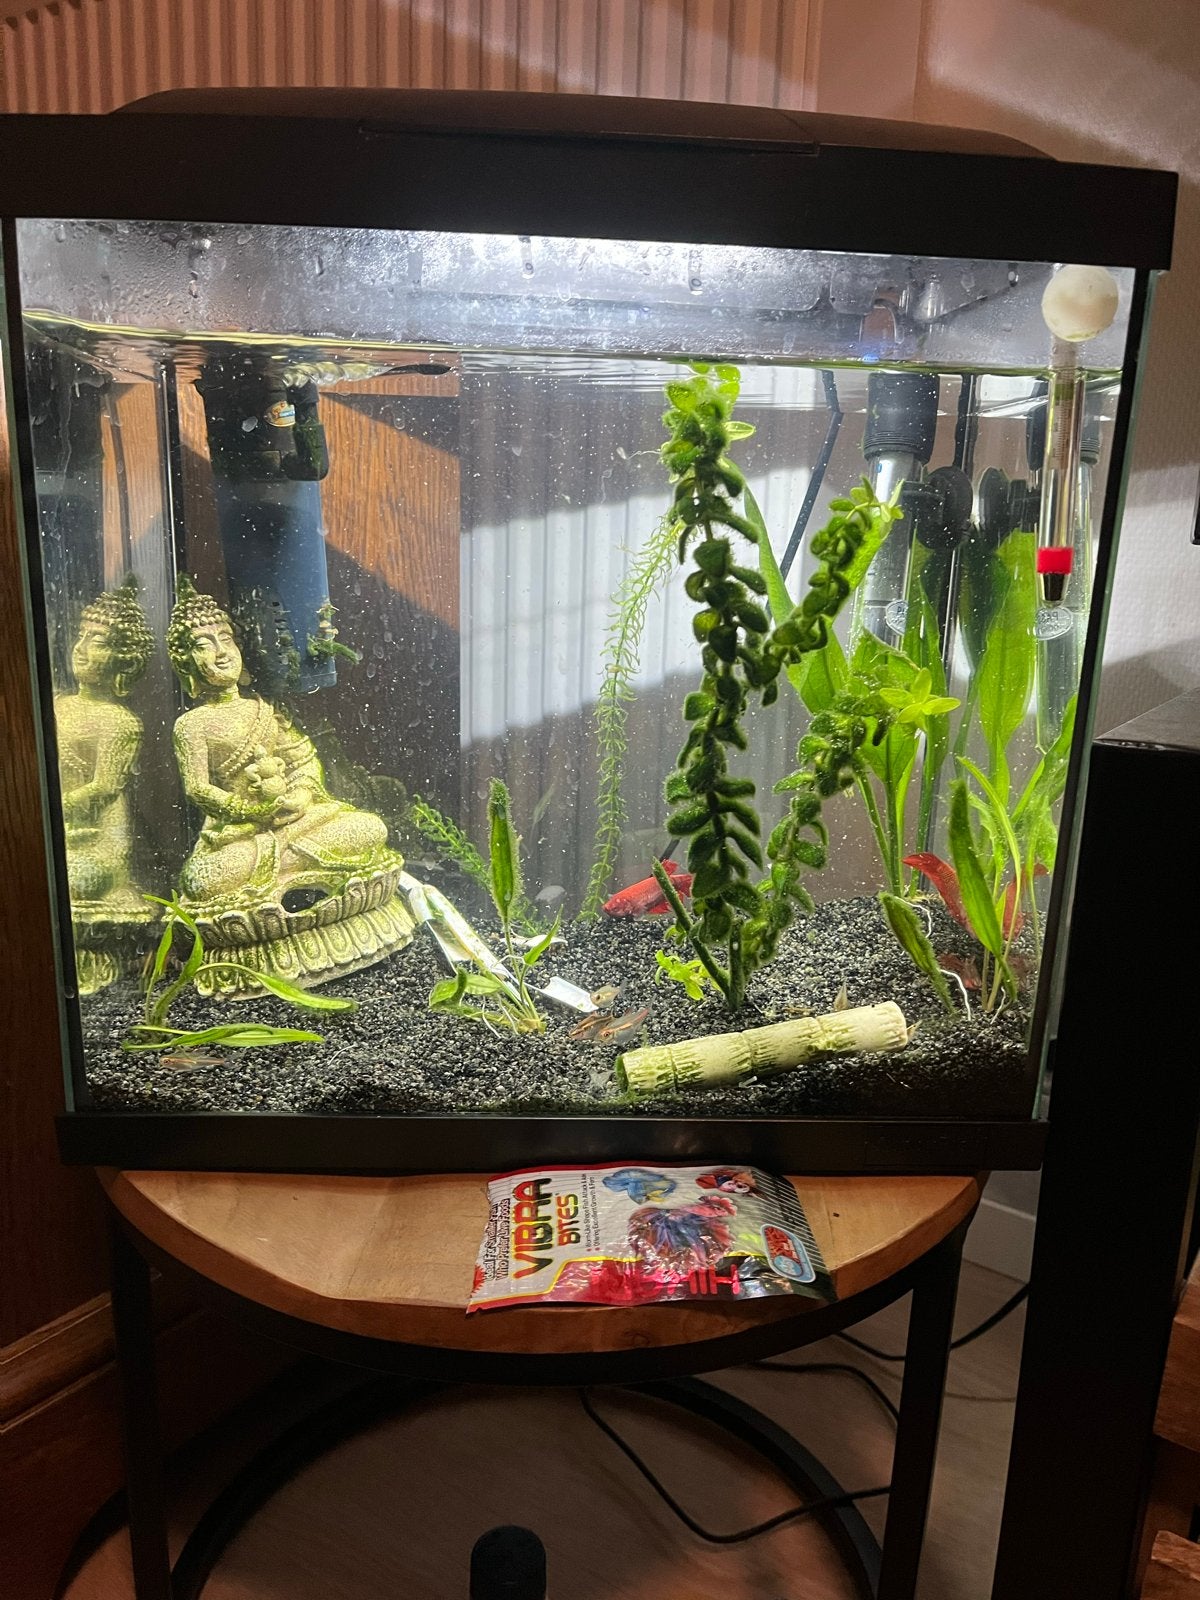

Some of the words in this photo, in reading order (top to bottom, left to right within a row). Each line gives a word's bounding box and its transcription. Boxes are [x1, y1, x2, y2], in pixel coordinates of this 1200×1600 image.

[498, 1198, 510, 1221] Foods
[556, 1194, 581, 1246] BITES
[498, 1221, 509, 1237] Live
[511, 1178, 553, 1279] VIBRA
[497, 1237, 509, 1260] Prefer
[483, 1262, 496, 1280] Ideal
[496, 1262, 509, 1280] Who
